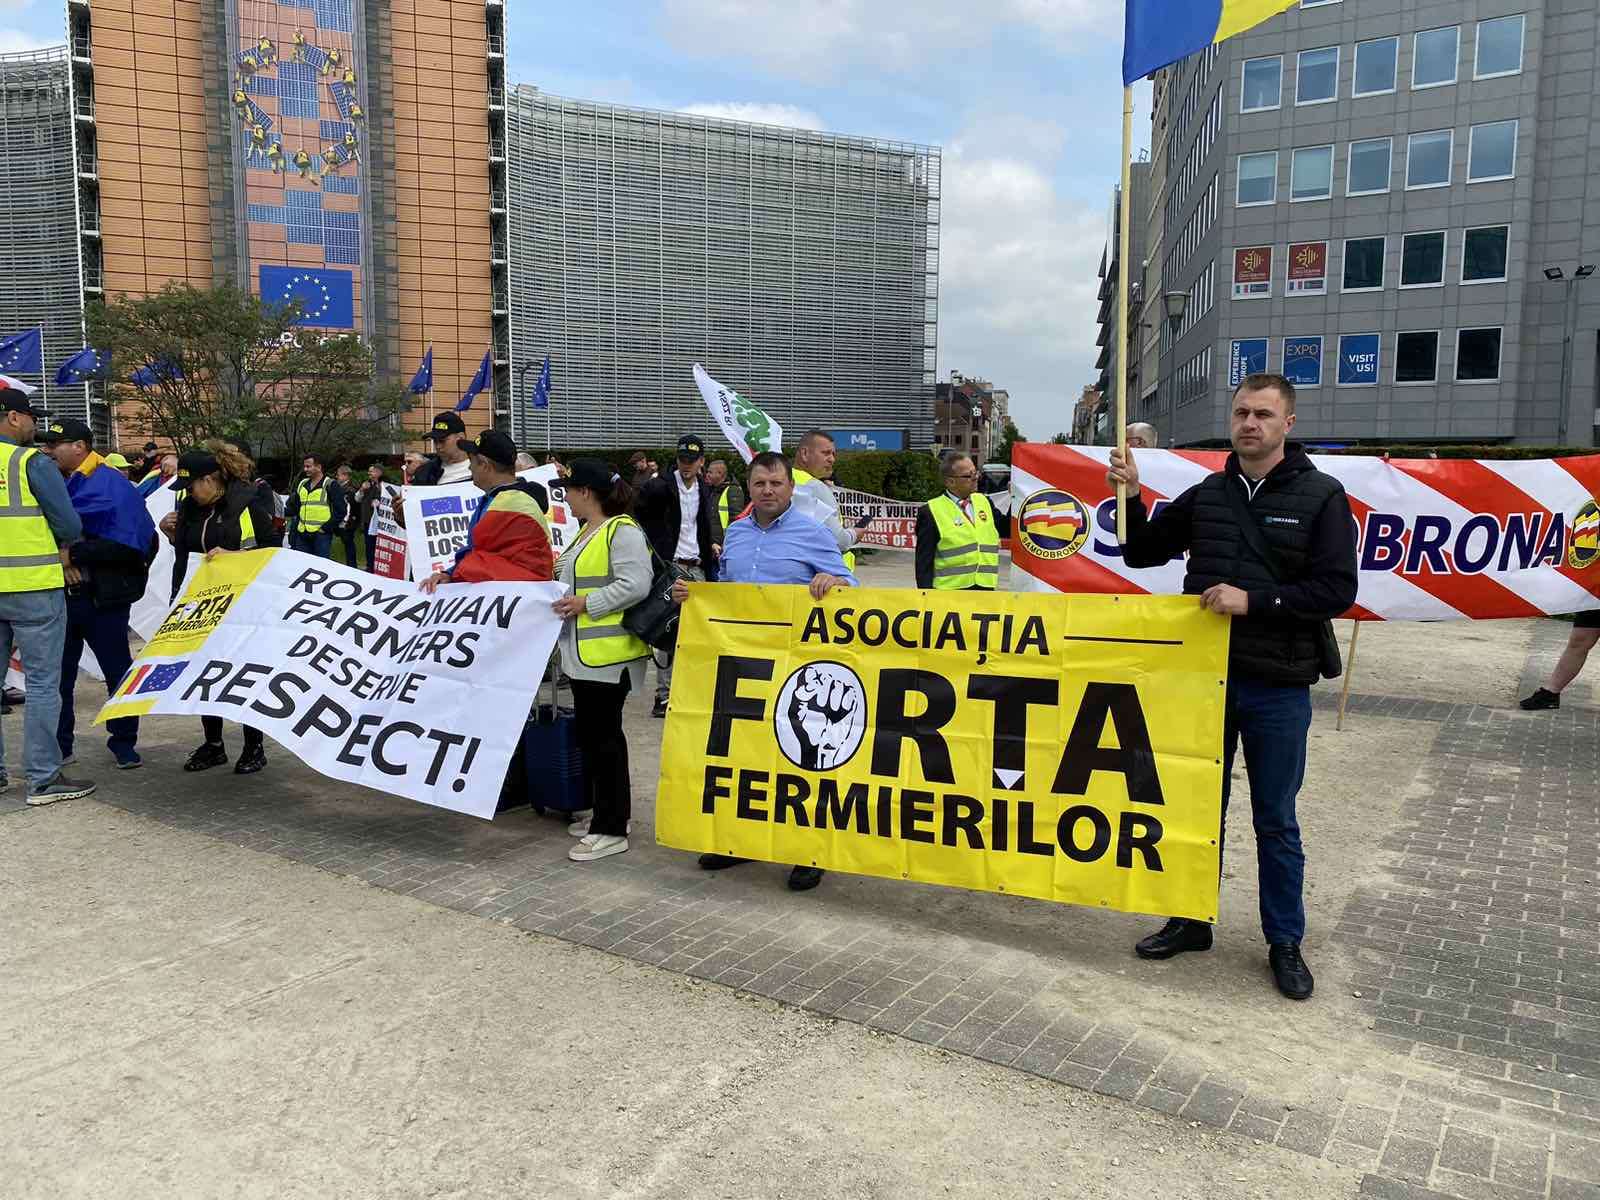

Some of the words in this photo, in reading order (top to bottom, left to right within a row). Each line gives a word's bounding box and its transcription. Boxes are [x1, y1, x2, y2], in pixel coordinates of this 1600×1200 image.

[1286, 344, 1319, 356] EXPO
[1349, 353, 1376, 363] VISIT
[1232, 342, 1241, 385] EXPERIENCE
[1240, 355, 1248, 381] UROPE
[1356, 363, 1374, 373] US!
[869, 505, 882, 518] DE
[886, 506, 919, 518] VULNE
[424, 516, 470, 537] ROM
[428, 535, 467, 558] LOS
[892, 535, 907, 547] OF
[1022, 535, 1082, 560] SAMOOBRONA
[289, 567, 522, 629] ROMANIAN
[282, 599, 481, 668] FARMERS
[286, 634, 427, 704] DESERVE
[181, 660, 482, 793] RESPECT!
[701, 764, 1165, 873] FERMIERILOR
